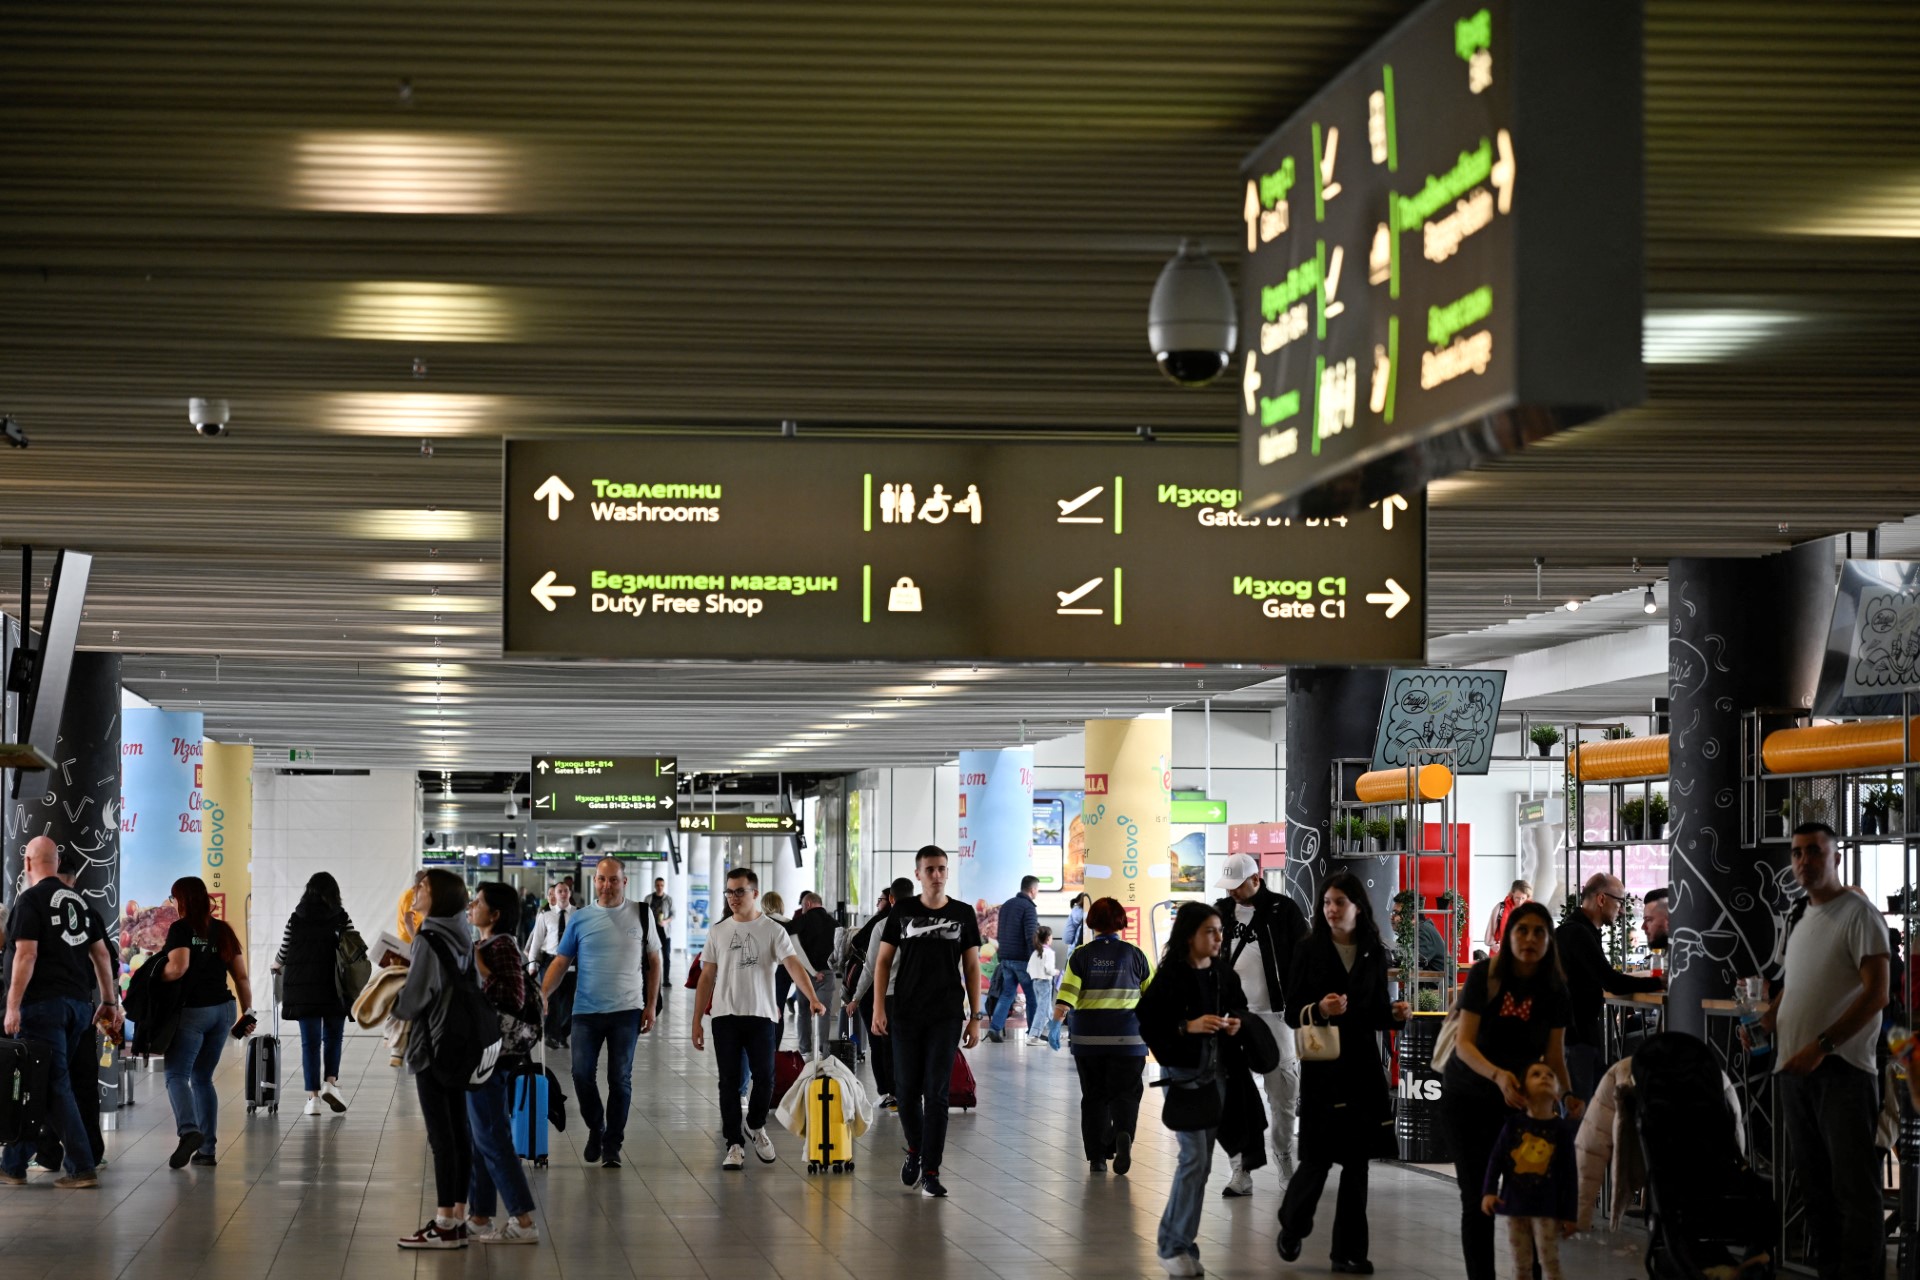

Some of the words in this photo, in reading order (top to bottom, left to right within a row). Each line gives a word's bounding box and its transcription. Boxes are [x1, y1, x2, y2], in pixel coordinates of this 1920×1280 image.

[592, 479, 721, 499] Тоалетни
[591, 501, 720, 522] Washrooms
[591, 570, 725, 594] Безмитен
[730, 575, 838, 596] магазин
[1233, 576, 1312, 599] Изход
[1318, 577, 1346, 596] C1
[591, 593, 647, 617] Duty
[652, 593, 700, 613] Free
[705, 593, 763, 618] Shop
[1262, 598, 1315, 618] Gate
[1320, 599, 1346, 618] C1
[554, 760, 584, 770] Изходи
[554, 767, 574, 775] Gates
[575, 795, 604, 803] Изходи
[588, 801, 608, 809] Gates
[207, 808, 224, 867] Glovo
[1122, 824, 1138, 879] Glovo
[1092, 957, 1116, 967] Sasse
